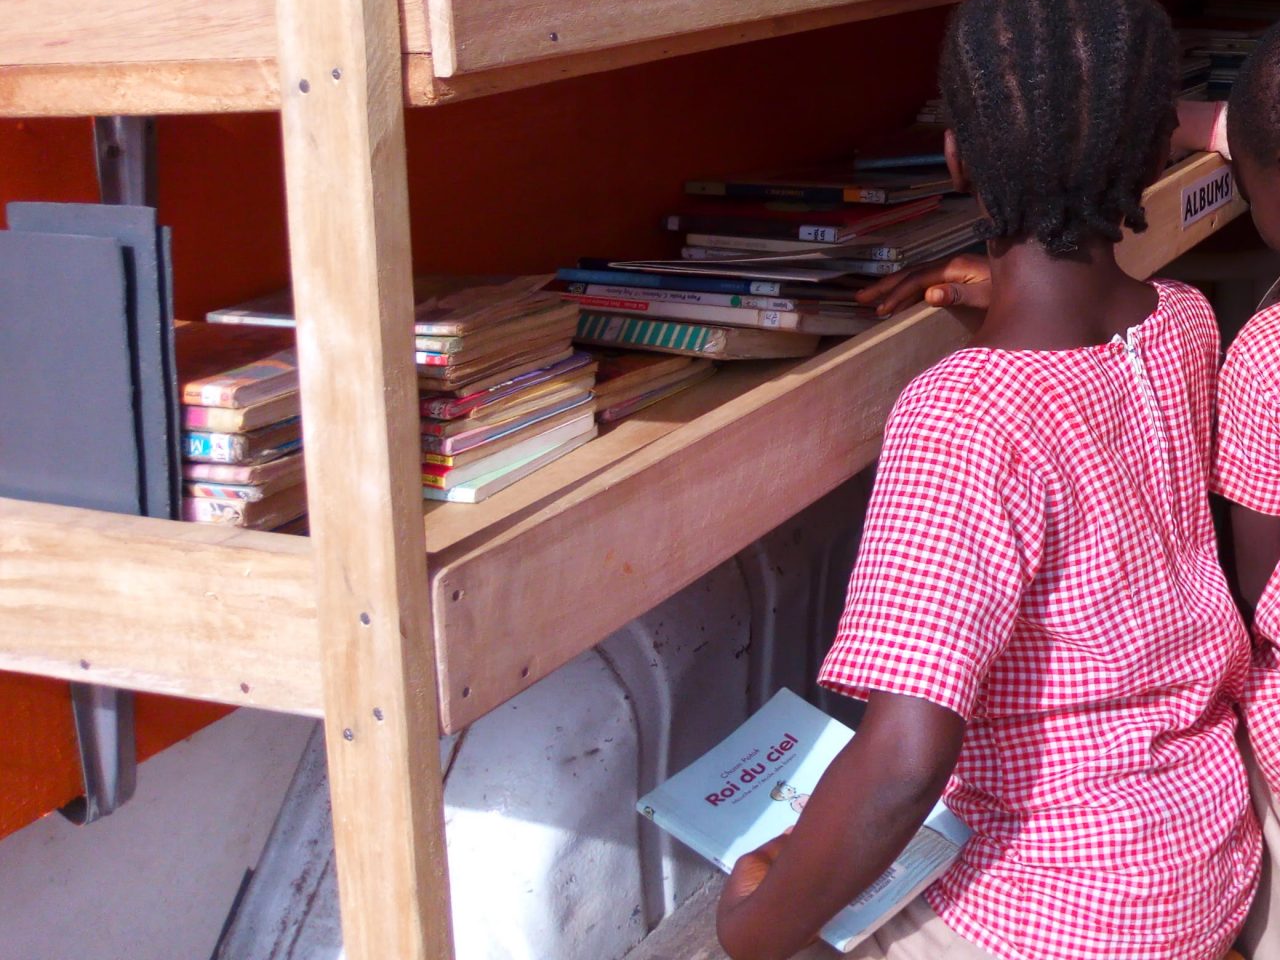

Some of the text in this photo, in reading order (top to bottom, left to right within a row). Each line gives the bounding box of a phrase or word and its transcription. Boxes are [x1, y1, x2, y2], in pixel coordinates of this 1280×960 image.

[1184, 171, 1231, 221] ALBUMS
[705, 732, 799, 807] Roi du ciel
